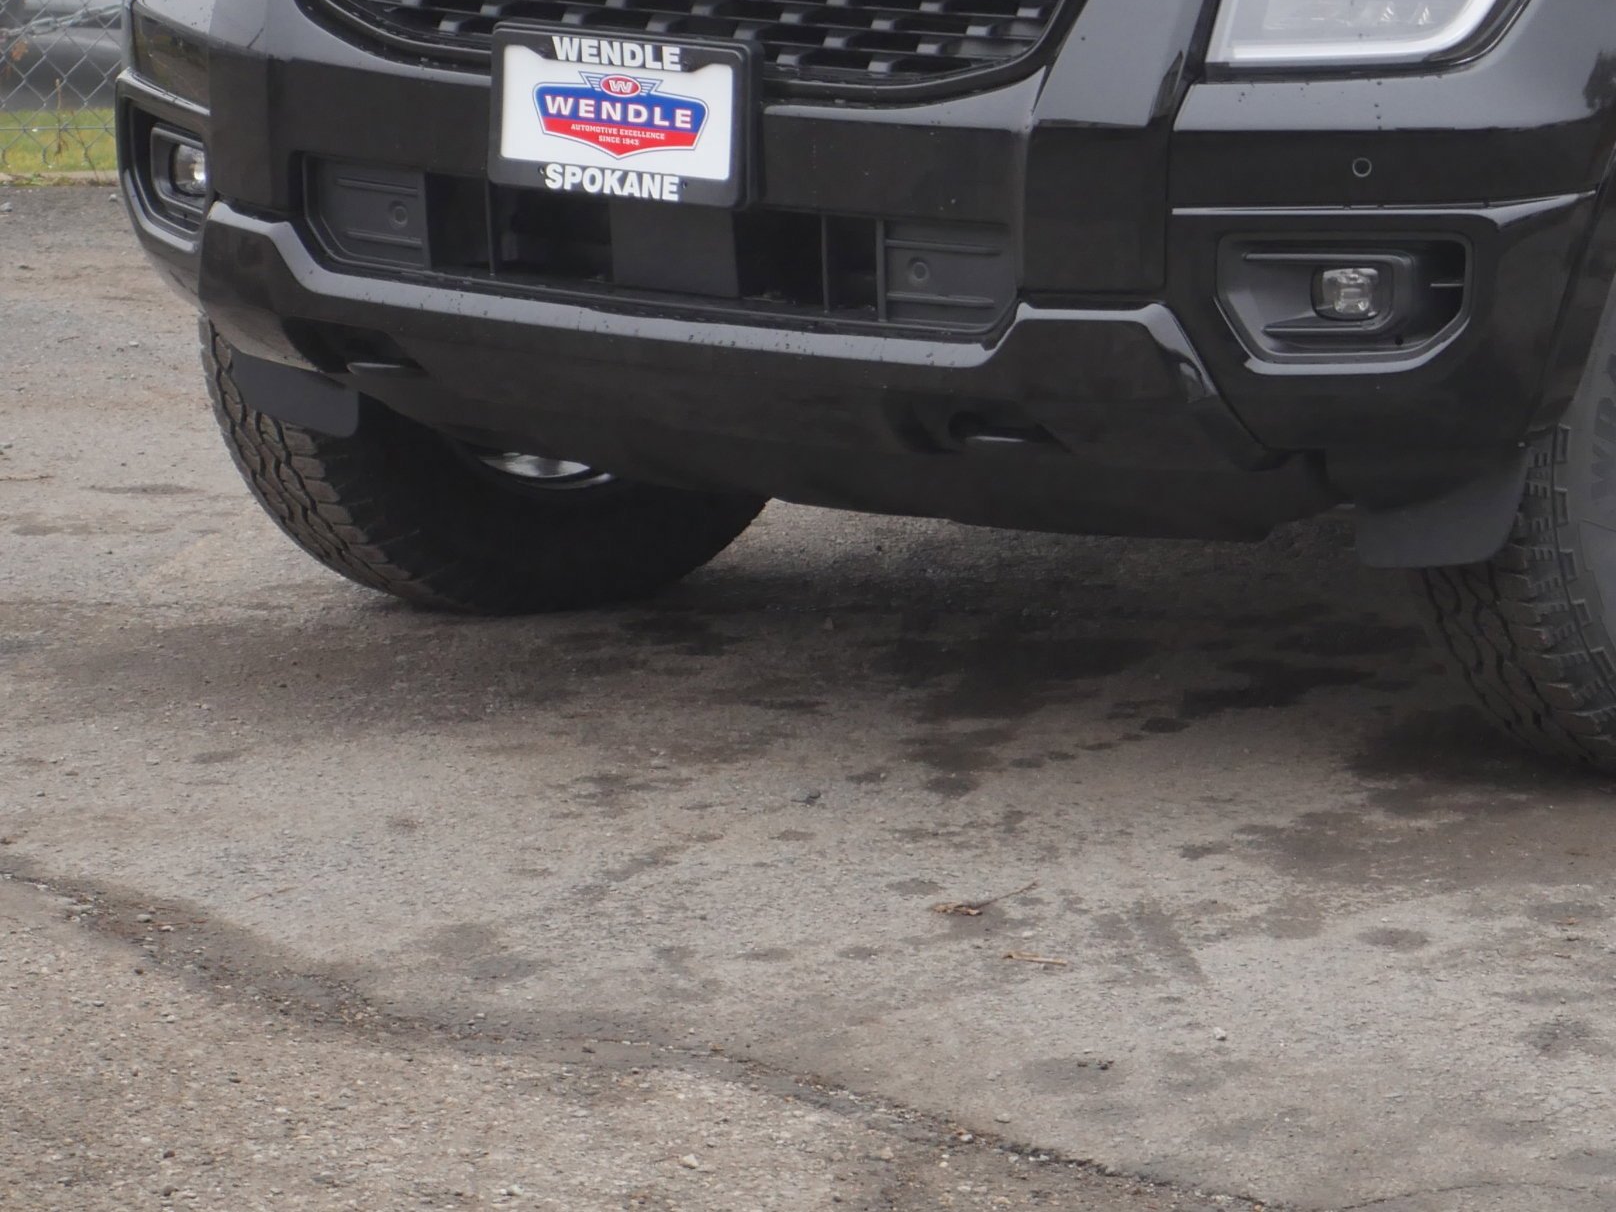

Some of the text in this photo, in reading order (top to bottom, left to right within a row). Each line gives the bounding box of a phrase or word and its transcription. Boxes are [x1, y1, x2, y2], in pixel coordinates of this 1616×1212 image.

[552, 36, 681, 71] WENDLE
[545, 95, 691, 129] WENDLE
[571, 124, 665, 140] AUTOMOTIVE EXCELLENCE
[599, 135, 640, 146] SINCE 1943
[545, 163, 679, 202] SPOKANE
